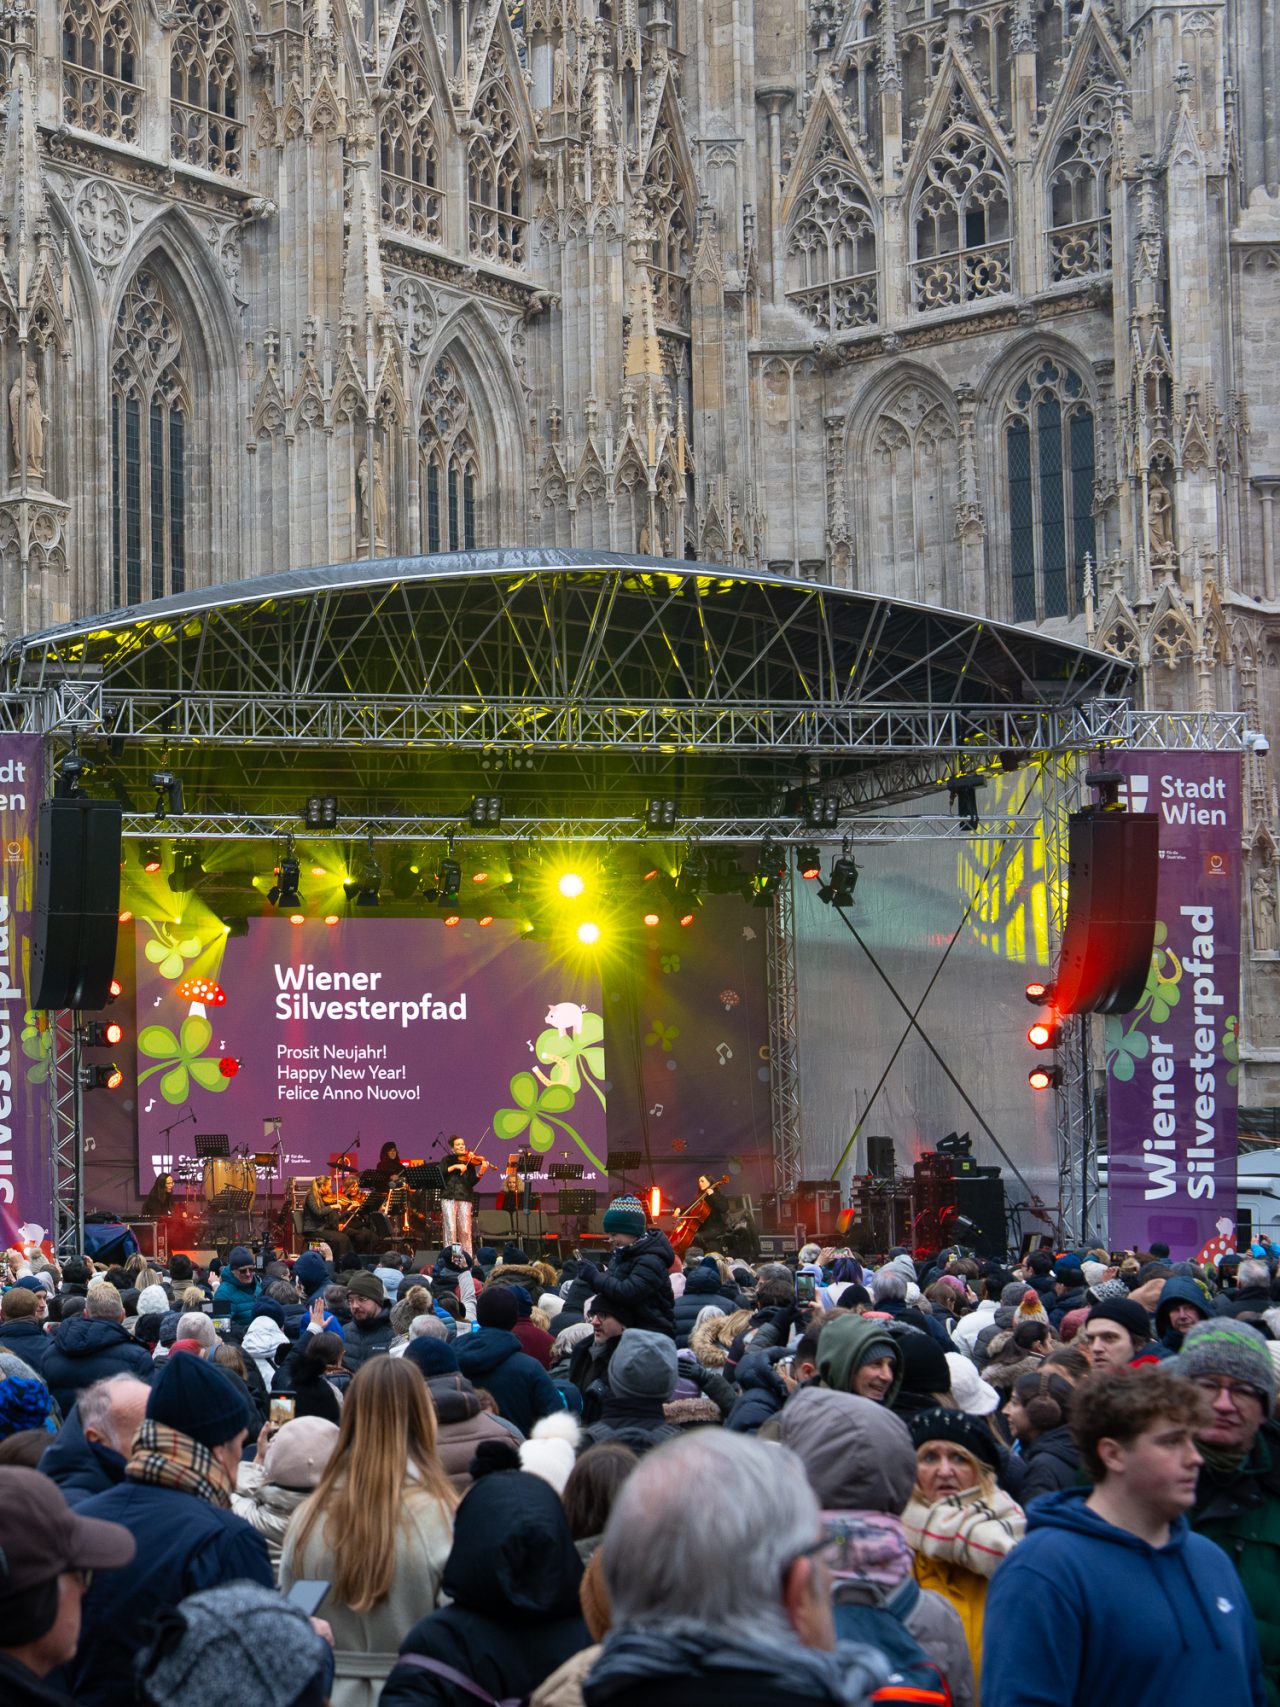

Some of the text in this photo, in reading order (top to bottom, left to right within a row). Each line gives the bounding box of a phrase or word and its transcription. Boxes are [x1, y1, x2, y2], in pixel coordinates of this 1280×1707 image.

[1160, 775, 1226, 799] Stadt
[1161, 801, 1227, 826] Wien
[274, 964, 382, 991] Wiener
[275, 993, 467, 1028] Silvesterpfad
[277, 1045, 387, 1063] Prosit Neujahr!
[1180, 905, 1225, 1200] Silvesterpfad
[277, 1065, 406, 1084] Happy New Year!
[278, 1085, 420, 1100] Felice Anno Nuovo!
[1142, 1035, 1177, 1201] Wiener
